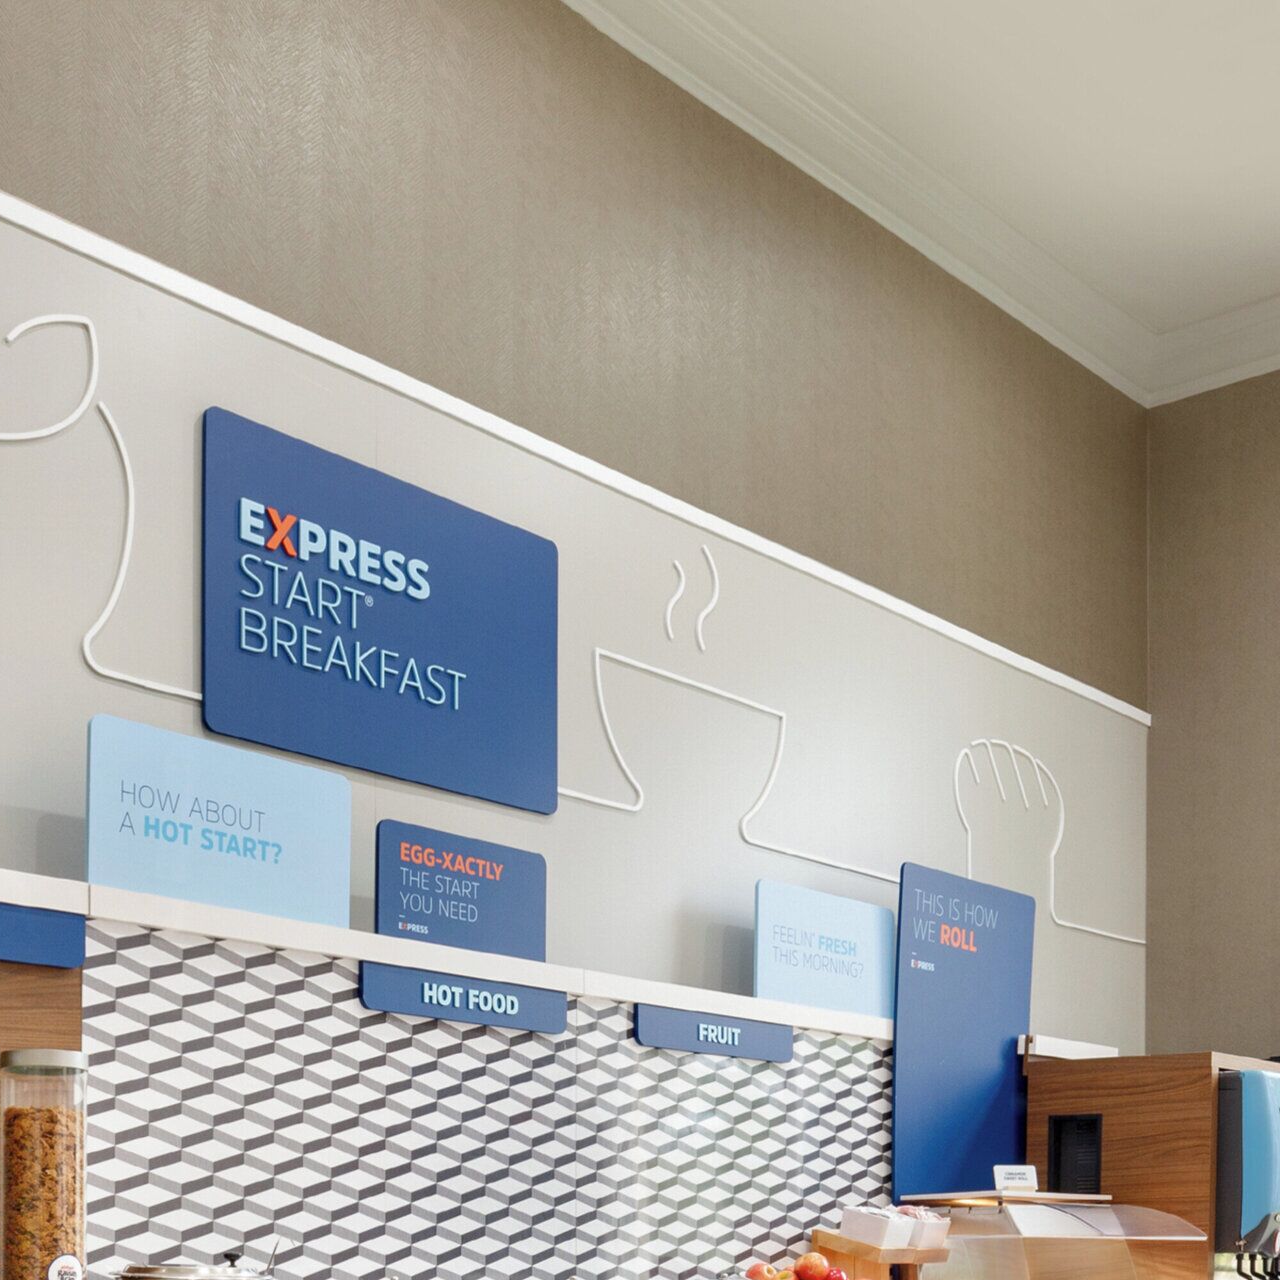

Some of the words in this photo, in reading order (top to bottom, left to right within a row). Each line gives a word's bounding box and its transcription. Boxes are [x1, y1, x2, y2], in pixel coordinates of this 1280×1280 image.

[239, 497, 431, 600] EXPRESS
[239, 607, 467, 711] BREAKFAST
[120, 779, 181, 815] HOW
[188, 796, 266, 833] ABOUT
[119, 811, 136, 836] A
[143, 815, 193, 846] HOT
[200, 827, 283, 865] START?
[400, 841, 504, 881] EGG-XACTLY
[400, 866, 430, 891] THE
[434, 874, 480, 900] START
[399, 891, 433, 914] YOU
[438, 898, 478, 923] NEED
[914, 888, 944, 917] THIS
[948, 898, 961, 921] IS
[964, 902, 999, 929] HOW
[398, 921, 429, 935] EXPRESS
[818, 934, 857, 957] FRESH
[913, 917, 936, 944] WE
[940, 922, 978, 953] ROLL
[772, 945, 799, 968] THIS
[802, 951, 864, 980] MORNING?
[423, 982, 463, 1008] HOT
[468, 987, 519, 1016] FOOD
[698, 1023, 742, 1046] FRUIT
